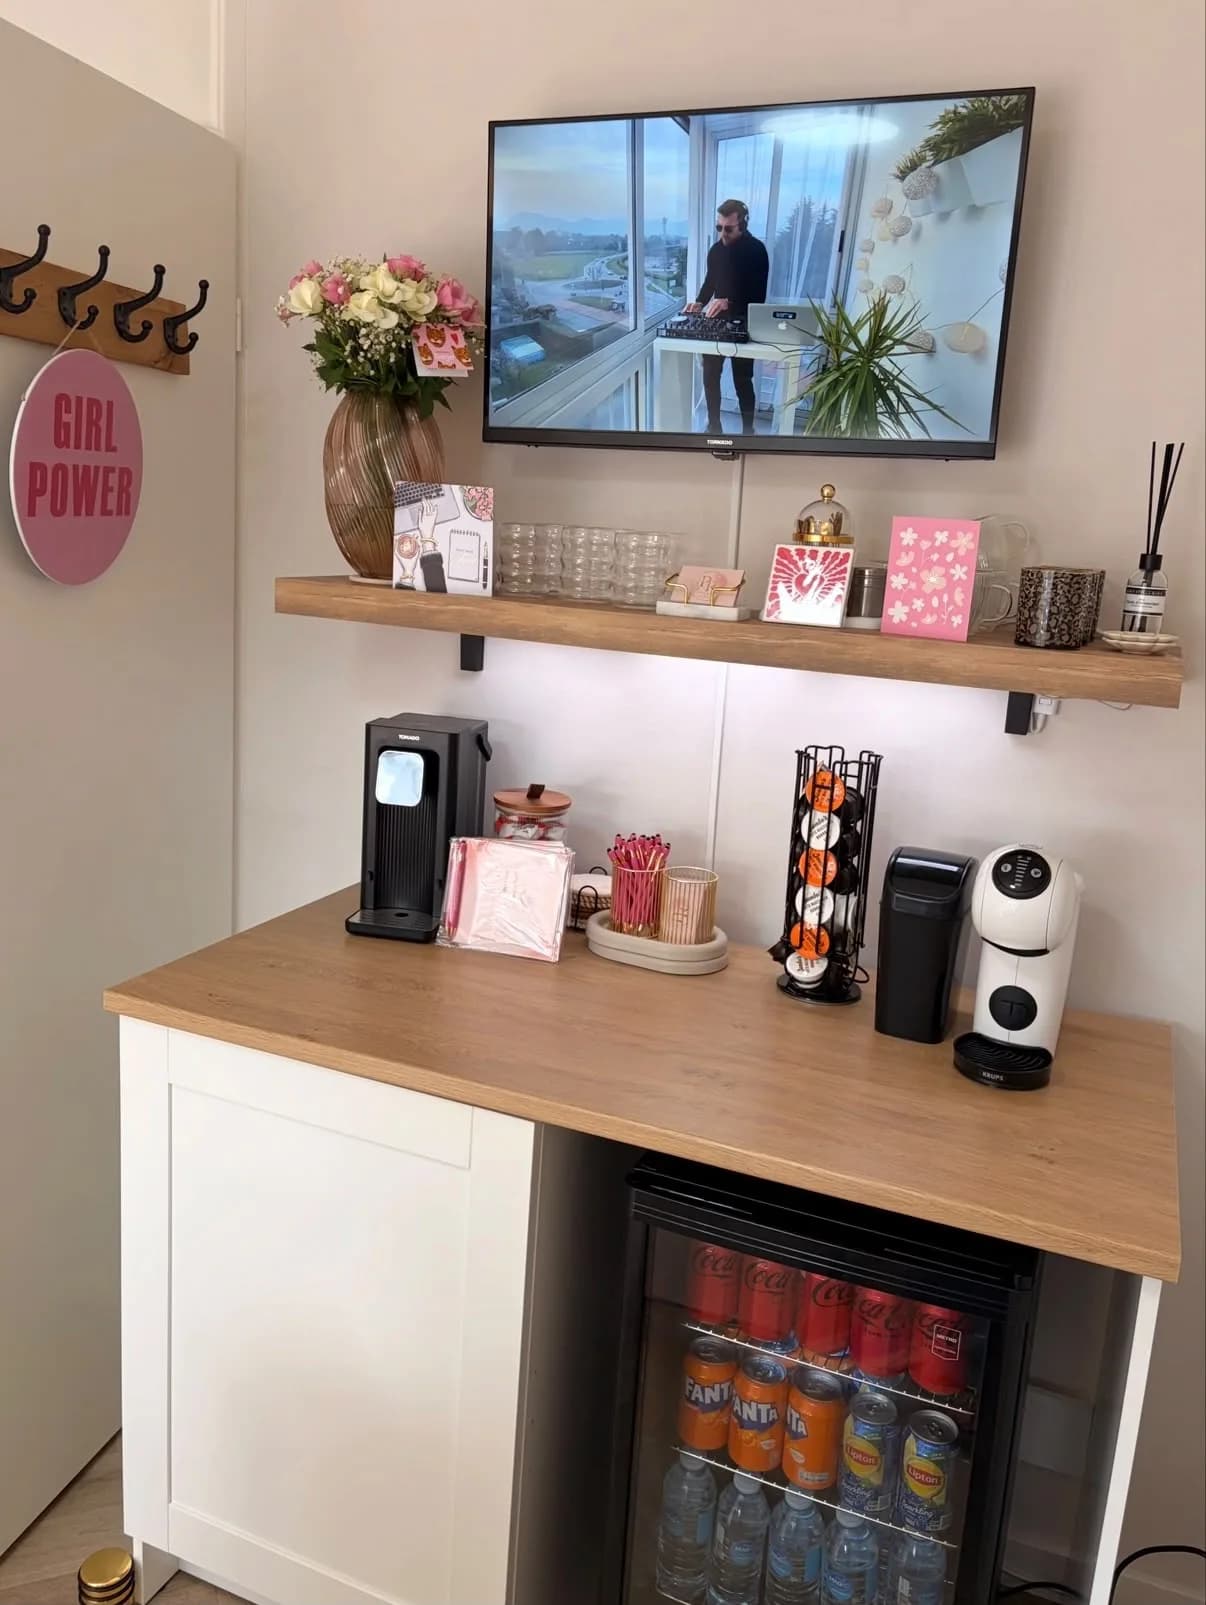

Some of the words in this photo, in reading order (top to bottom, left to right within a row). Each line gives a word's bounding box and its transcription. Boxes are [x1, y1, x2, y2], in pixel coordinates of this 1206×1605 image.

[54, 393, 117, 452] GIRL
[28, 461, 133, 517] POWER
[982, 1071, 1004, 1081] KRUPS
[685, 1375, 734, 1405] FANT
[732, 1395, 779, 1424] ANTA
[847, 1445, 876, 1465] Lipton
[908, 1466, 938, 1484] Lipton
